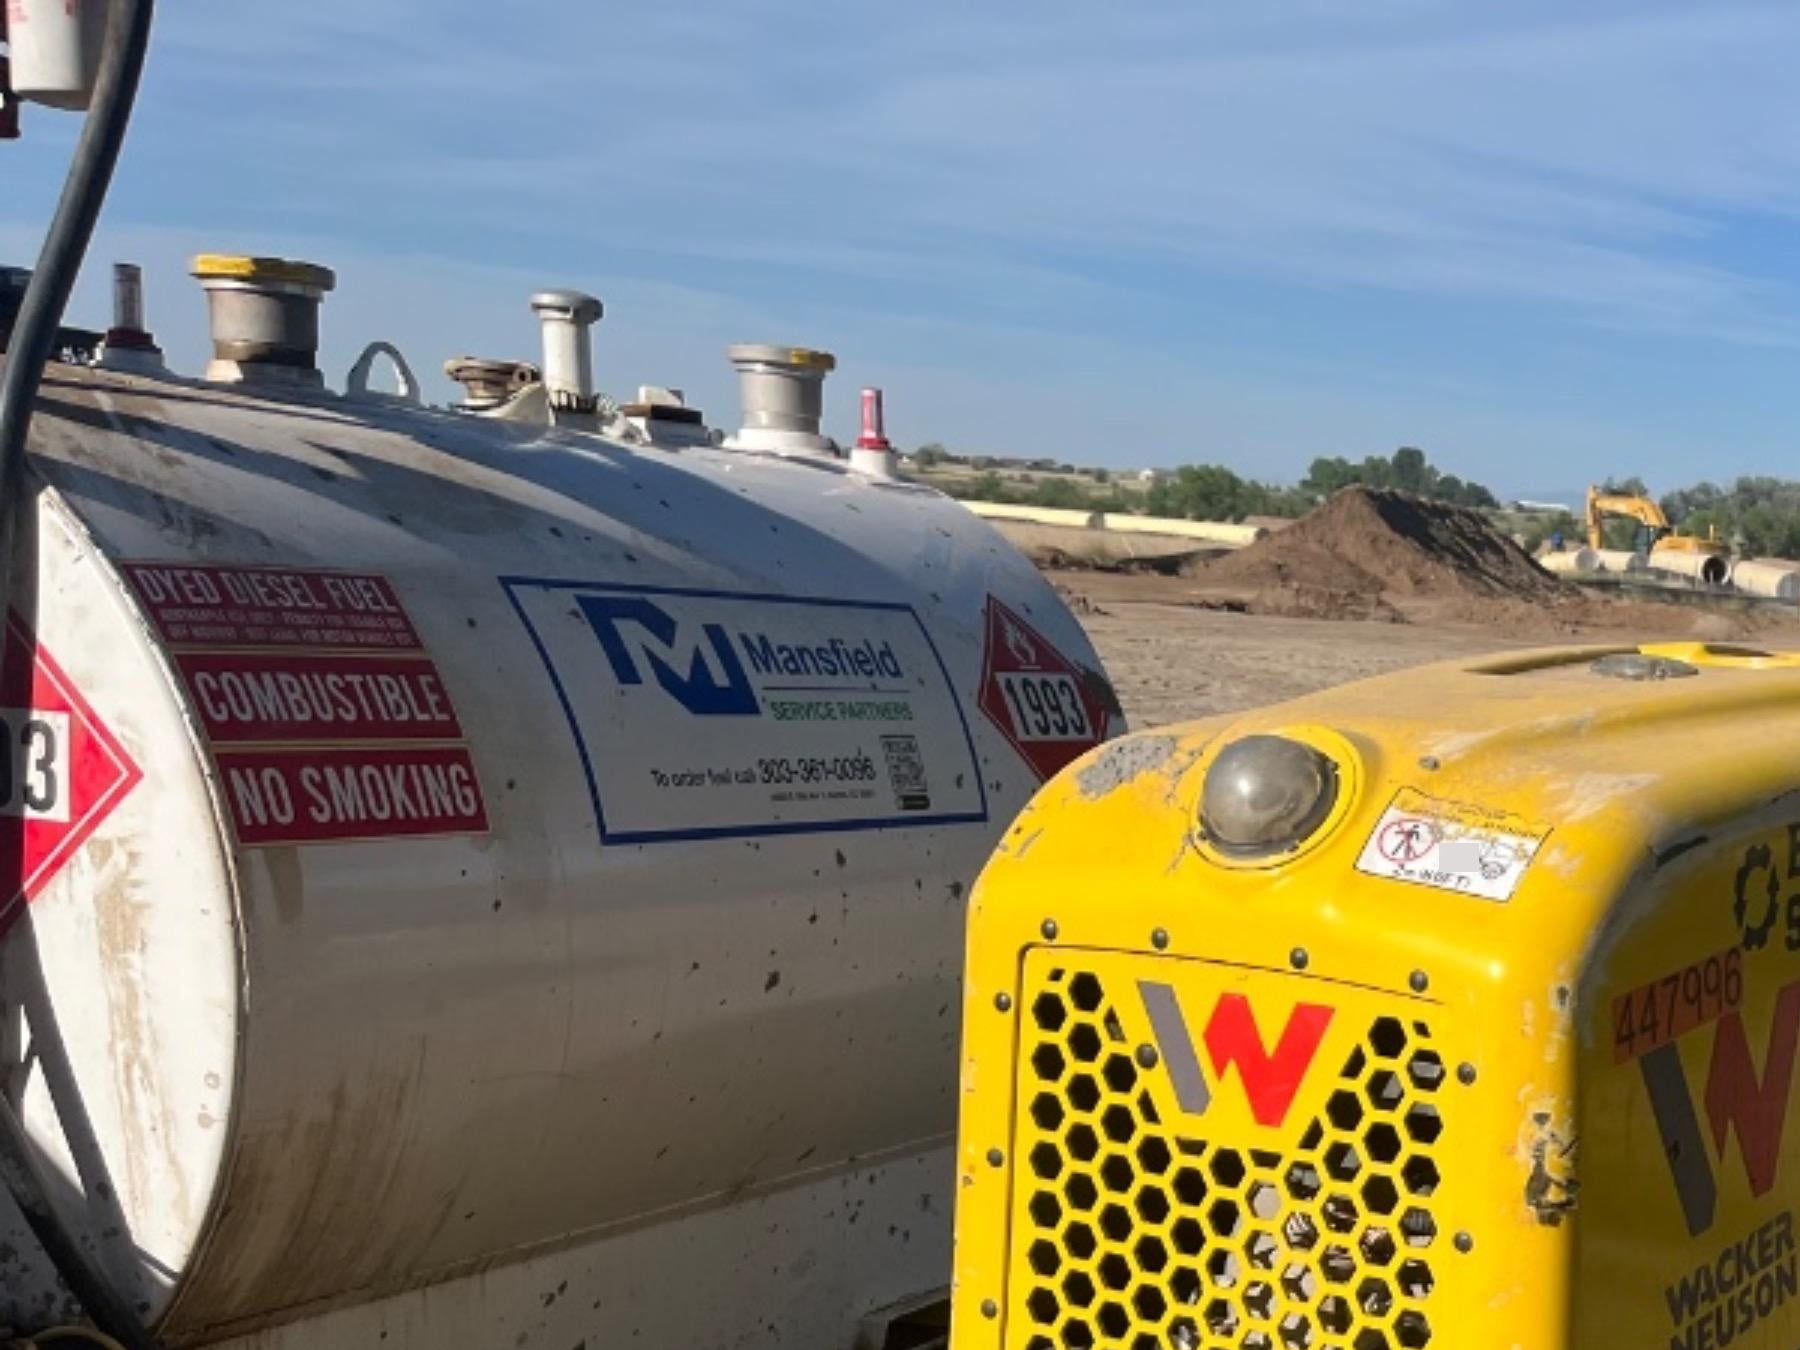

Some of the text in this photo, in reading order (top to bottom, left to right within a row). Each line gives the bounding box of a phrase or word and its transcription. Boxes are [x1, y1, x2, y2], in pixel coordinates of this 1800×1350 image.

[134, 569, 399, 611] DYED DIESEL FUEL
[739, 631, 903, 680] Mansfield
[194, 671, 451, 722] COMBUSTIBLE
[770, 699, 914, 721] SERVICE PARTNERS
[1003, 676, 1091, 740] 1993
[229, 762, 479, 827] NO SMOKING
[649, 769, 670, 787] To
[1615, 947, 1744, 1054] 447996
[1663, 1210, 1797, 1327] WACKER
